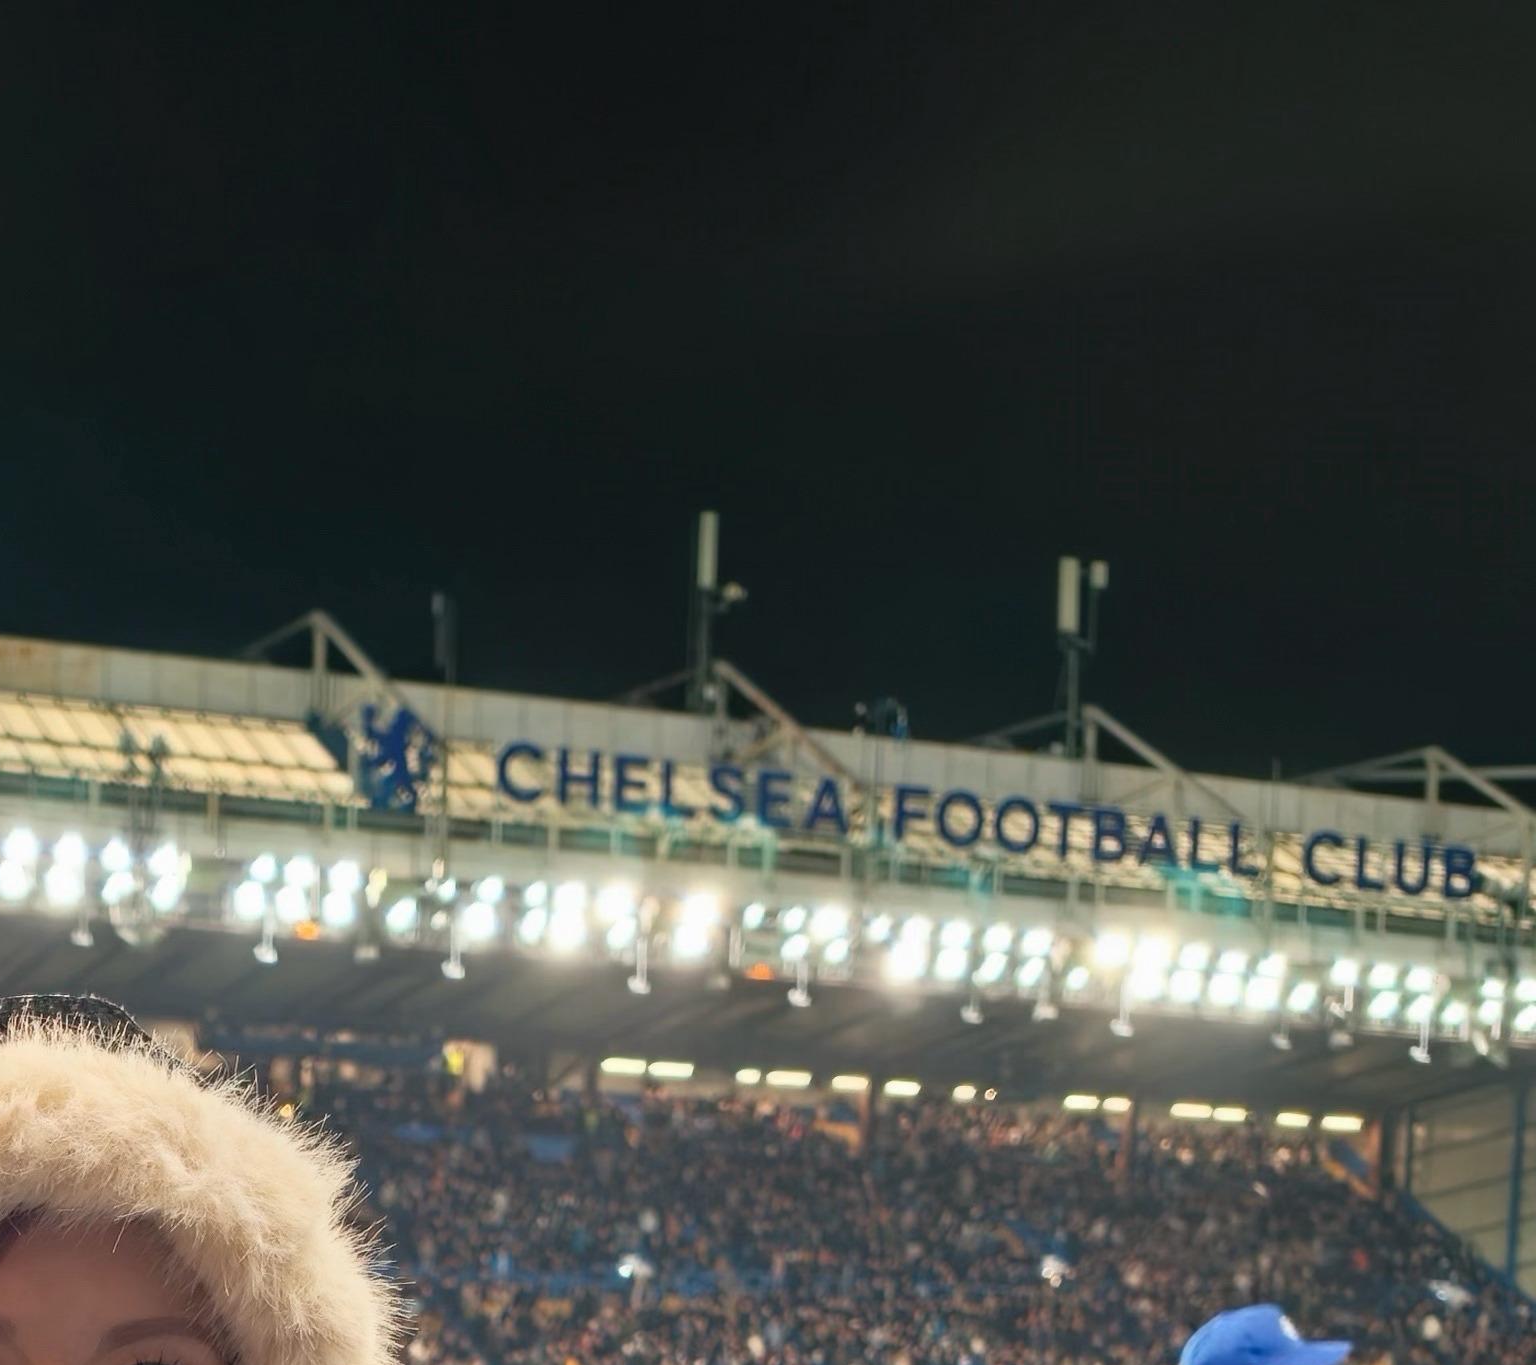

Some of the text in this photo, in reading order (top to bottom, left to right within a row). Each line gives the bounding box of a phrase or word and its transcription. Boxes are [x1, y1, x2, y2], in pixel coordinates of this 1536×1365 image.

[497, 741, 1476, 897] CHELSEA FOOTBALL CLUB
